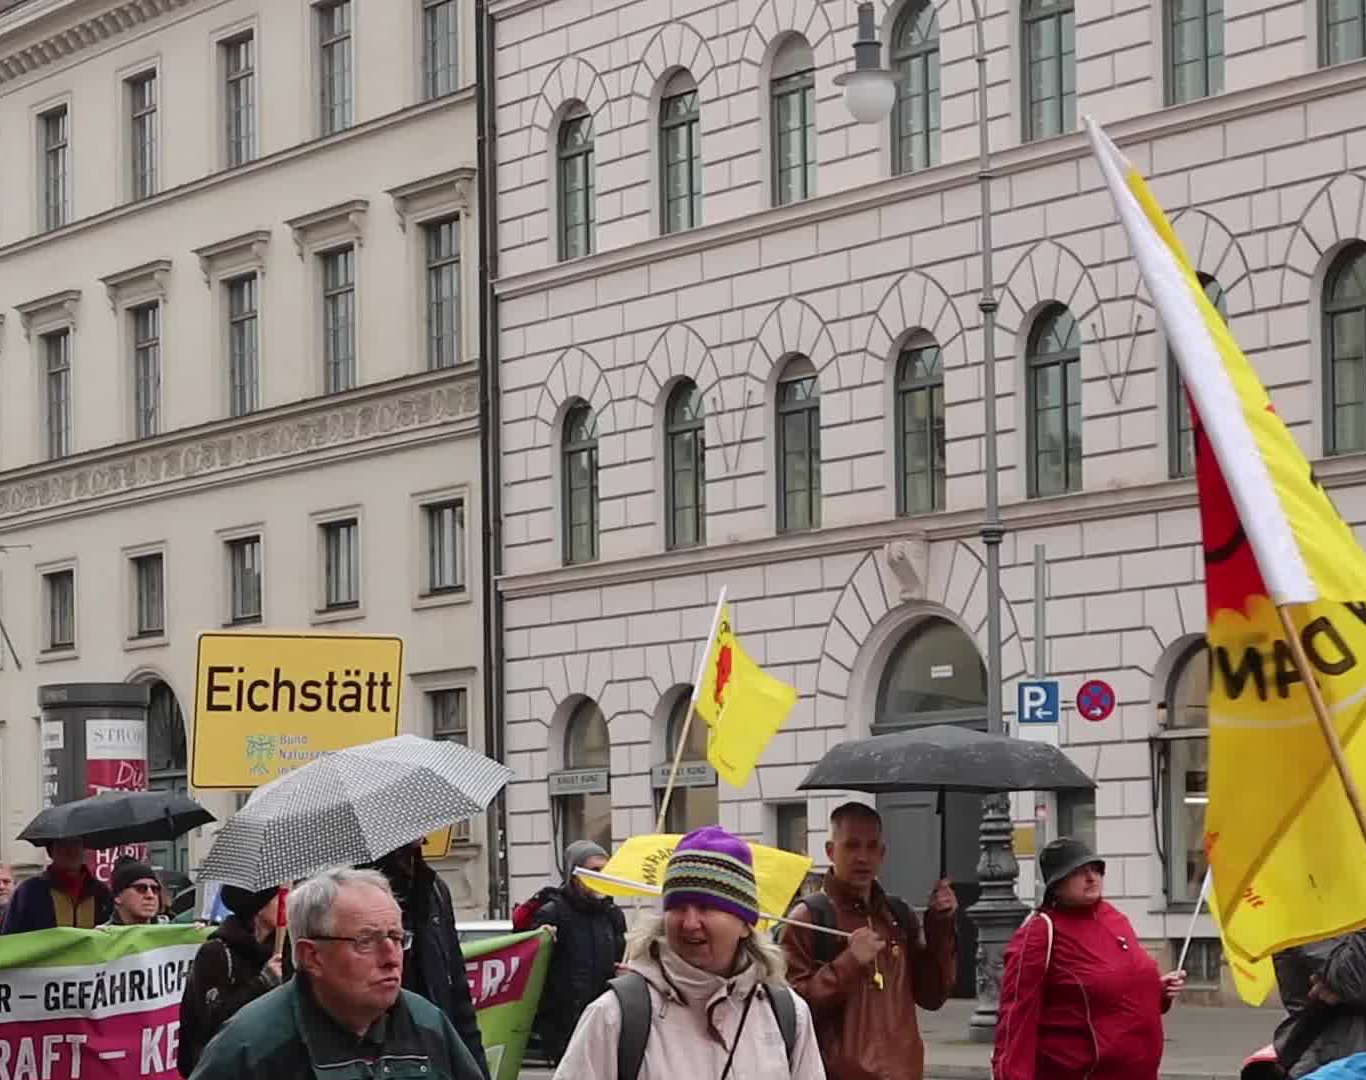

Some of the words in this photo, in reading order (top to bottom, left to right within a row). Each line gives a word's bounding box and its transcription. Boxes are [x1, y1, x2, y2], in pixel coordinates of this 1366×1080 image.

[206, 666, 392, 713] Eichstätt
[1023, 686, 1047, 719] P
[43, 959, 195, 1011] GEFÄHRLICH
[466, 955, 521, 1005] ER!
[140, 1021, 180, 1076] KE
